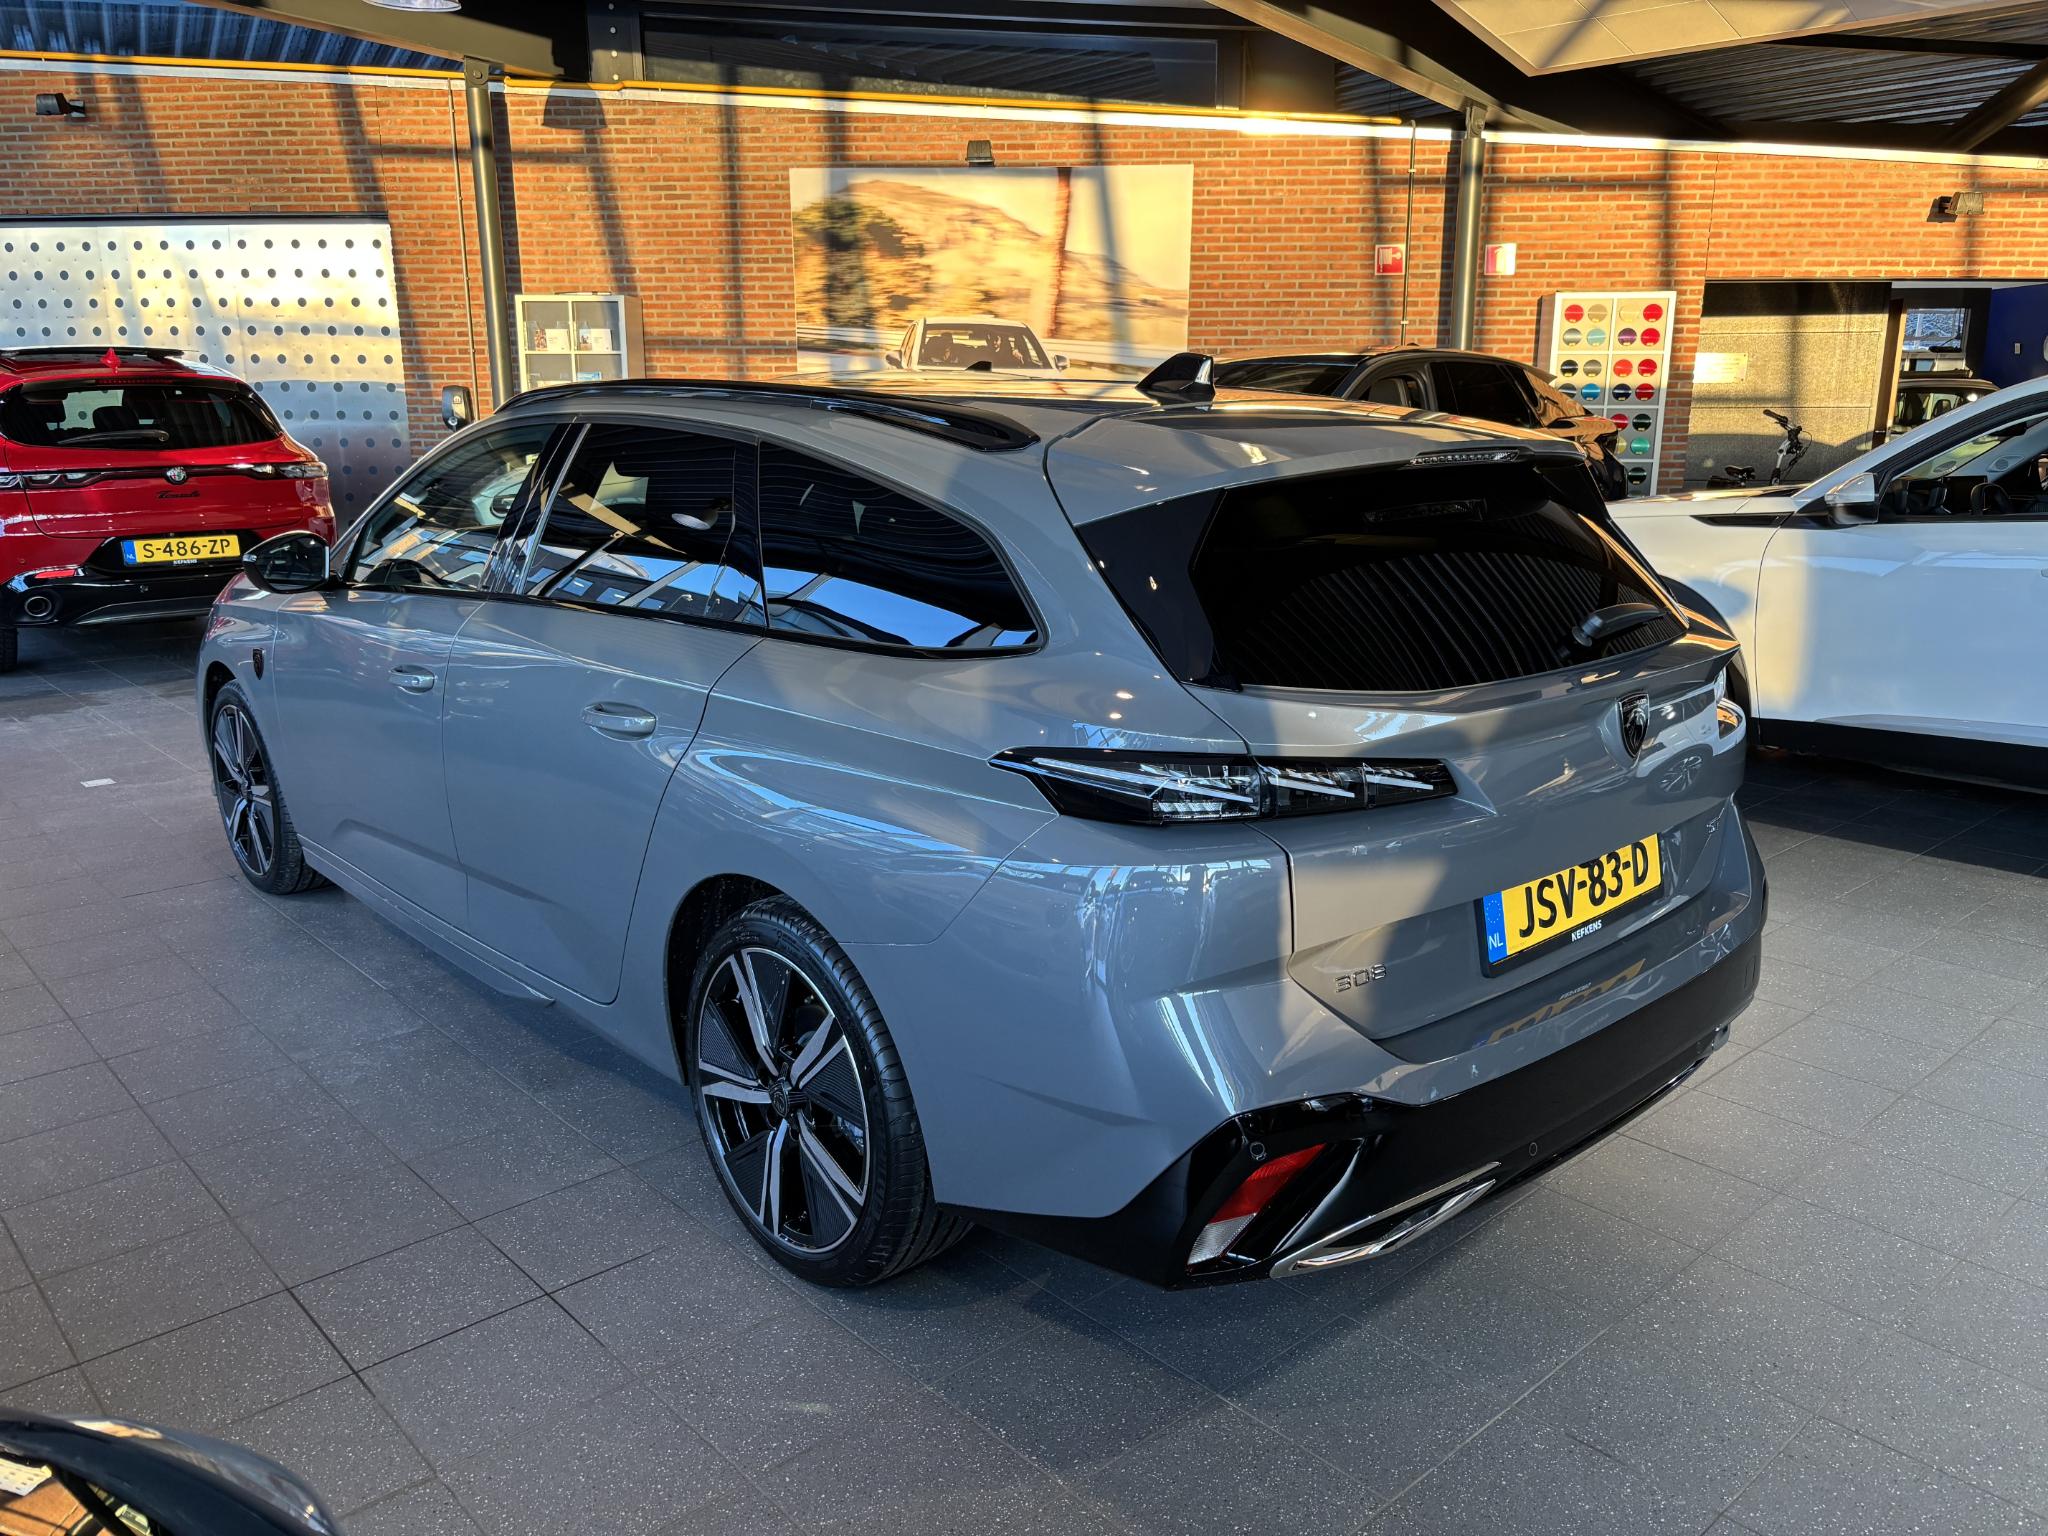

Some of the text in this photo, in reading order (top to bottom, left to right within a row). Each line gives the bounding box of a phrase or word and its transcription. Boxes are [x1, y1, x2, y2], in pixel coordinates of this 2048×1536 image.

[142, 539, 231, 559] S-486-ZP
[1519, 841, 1649, 938] JSV-83-D
[1488, 932, 1504, 950] NL
[1571, 919, 1603, 942] NEFKENS
[1333, 961, 1387, 993] 308
